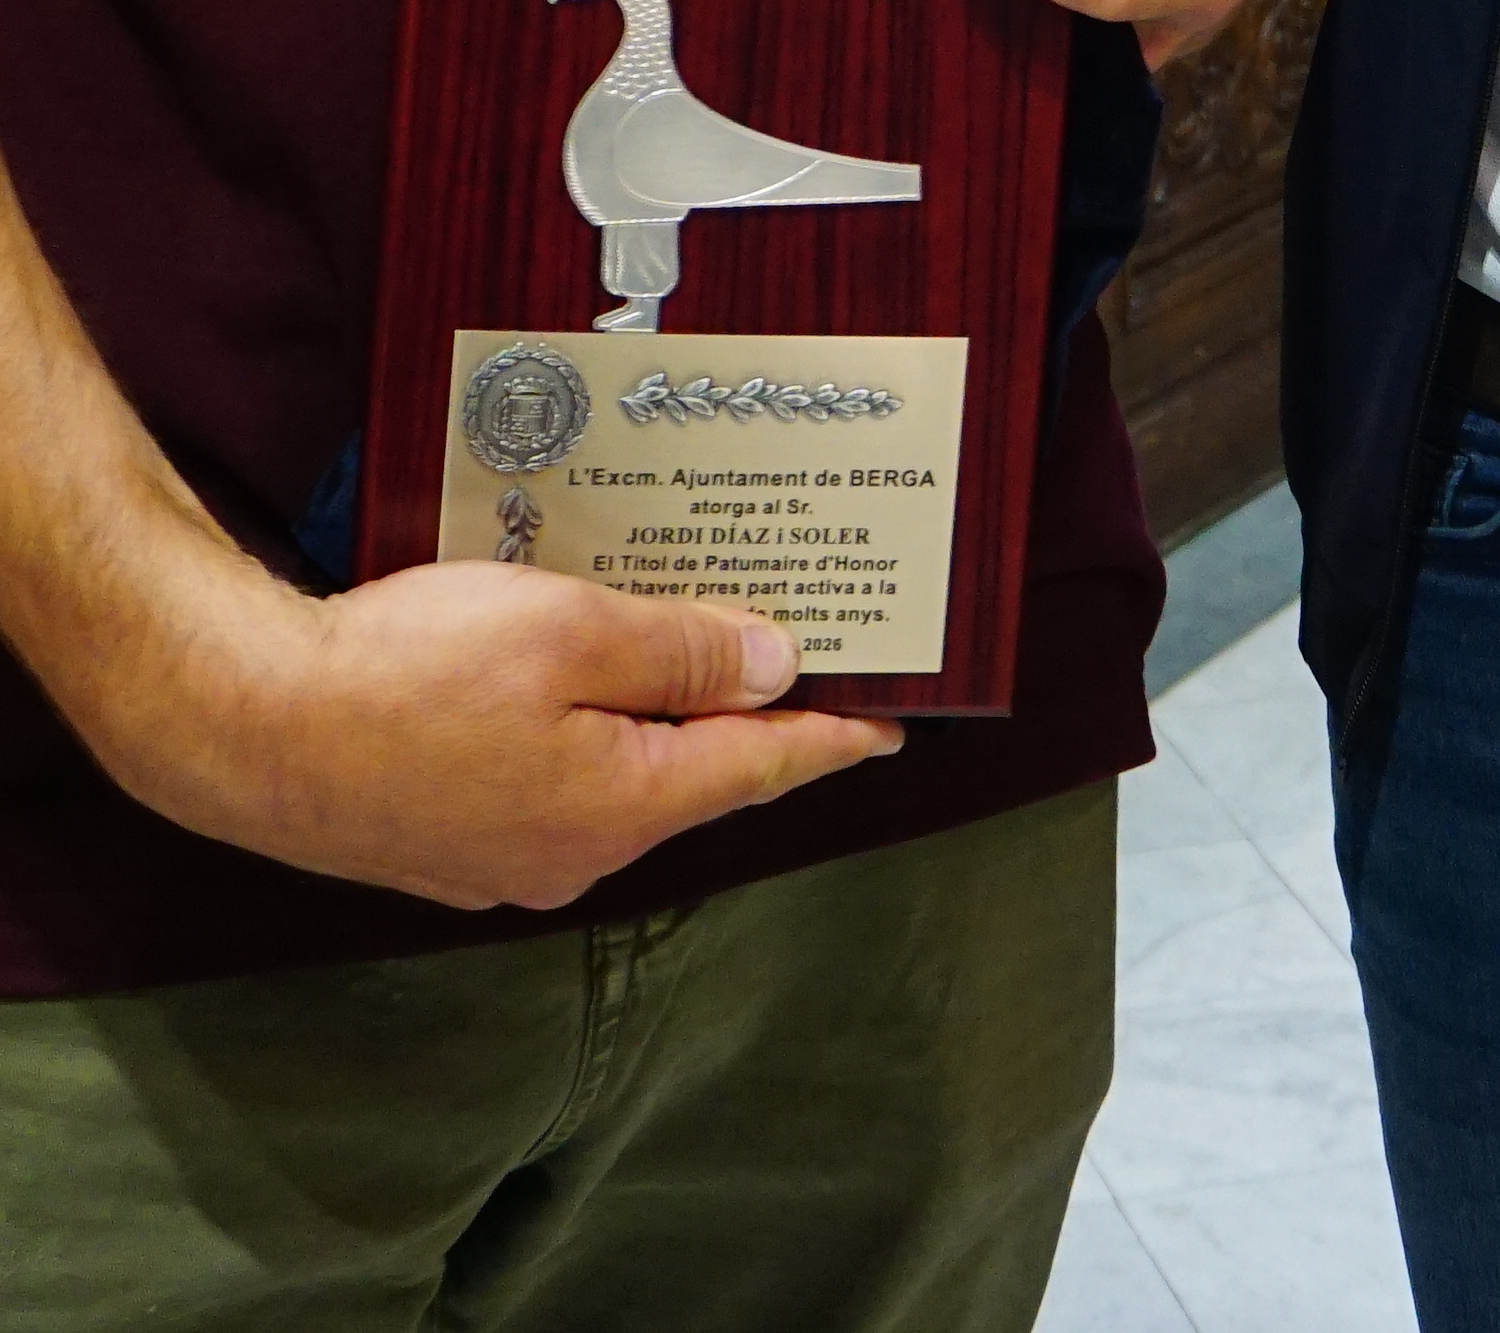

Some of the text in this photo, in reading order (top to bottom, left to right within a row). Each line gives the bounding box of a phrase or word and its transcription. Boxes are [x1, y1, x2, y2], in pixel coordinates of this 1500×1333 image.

[567, 467, 936, 491] L'Excm. Ajuntament de BERGA
[689, 499, 814, 517] atorga al Sr.
[626, 527, 704, 545] JORDI
[710, 522, 770, 545] DÍAZ
[789, 527, 870, 545] SOLER
[593, 555, 613, 572] El
[672, 555, 698, 572] de
[704, 555, 809, 572] Patumaire
[815, 555, 899, 572] d'Honor
[630, 579, 690, 596] haver
[695, 582, 741, 599] pres
[746, 579, 788, 598] part
[794, 579, 855, 596] activa
[861, 582, 872, 596] a
[879, 579, 897, 596] la
[772, 605, 830, 622] molts
[835, 609, 891, 626] anys.
